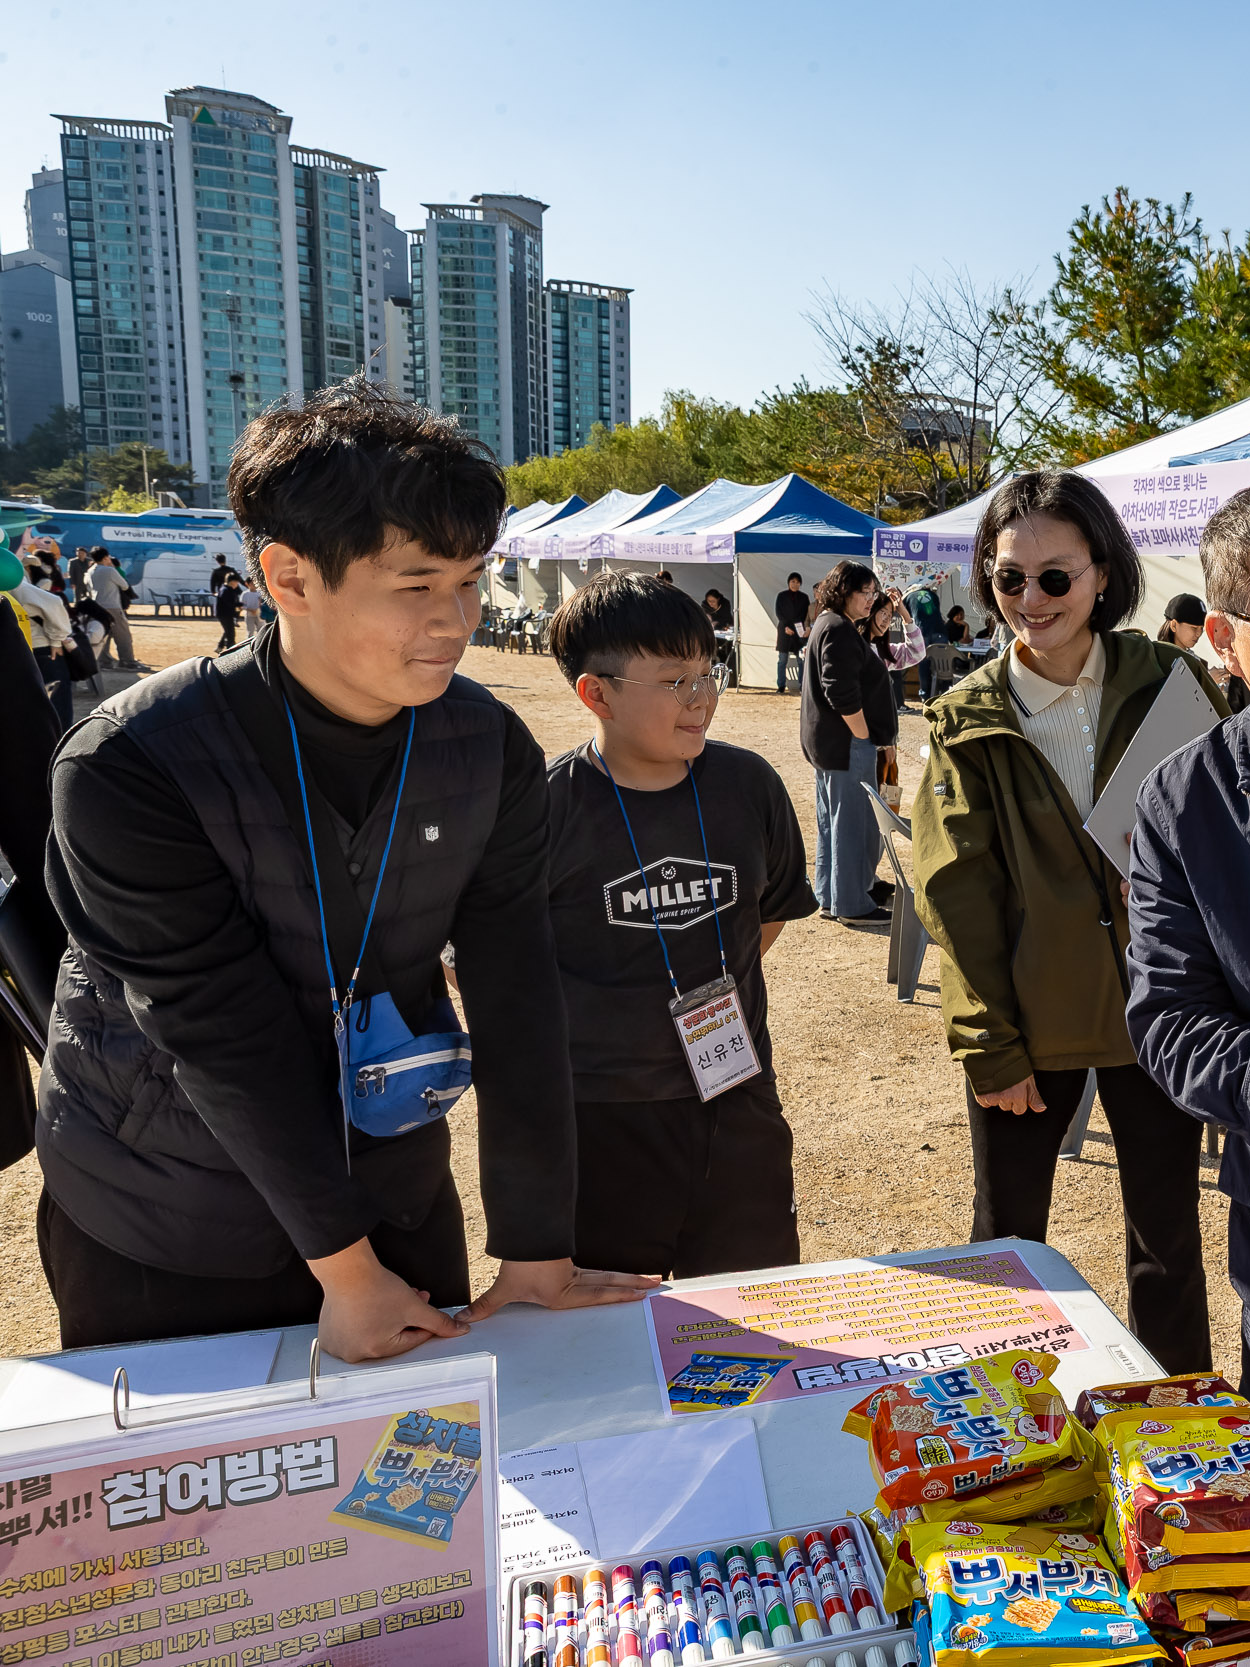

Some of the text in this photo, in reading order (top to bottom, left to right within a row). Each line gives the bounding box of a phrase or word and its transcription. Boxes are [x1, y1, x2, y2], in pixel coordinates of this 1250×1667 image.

[25, 311, 53, 324] 1002
[1132, 471, 1208, 495] 각자의 색으로 빛나는
[1121, 495, 1219, 523] 아차산아래 작은도서관
[113, 529, 223, 542] Virtual Reality Experience
[936, 542, 969, 553] 공동육아
[622, 877, 723, 913] MILLET
[683, 997, 733, 1030] 성문화동아리
[697, 1033, 745, 1070] 신유찬
[794, 1343, 974, 1391] 참여방법
[393, 1411, 482, 1461] 성차별
[99, 1435, 340, 1533] 참여방법
[373, 1447, 478, 1493] 뿌셔뿌셔
[501, 1467, 575, 1485] 여자는 긴머리
[542, 1509, 579, 1522] 여자는
[0, 1534, 209, 1599] 수처에 가서 서명한다.
[503, 1551, 541, 1563] 가지고
[554, 1549, 591, 1563] 여자가
[0, 1535, 348, 1634] 진청소년성문화 동아리 친구들이 만든
[947, 1555, 1121, 1606] 뿌셔뿌셔
[0, 1587, 253, 1667] 성평등 포스터를 관람한다.
[167, 1630, 210, 1654] 내가
[212, 1611, 273, 1644] 들었던
[276, 1597, 337, 1629] 성차별
[338, 1587, 379, 1615] 말을
[380, 1567, 473, 1605] 생각해보고
[323, 1617, 381, 1650] 샘플을
[383, 1600, 465, 1634] 참고한다)
